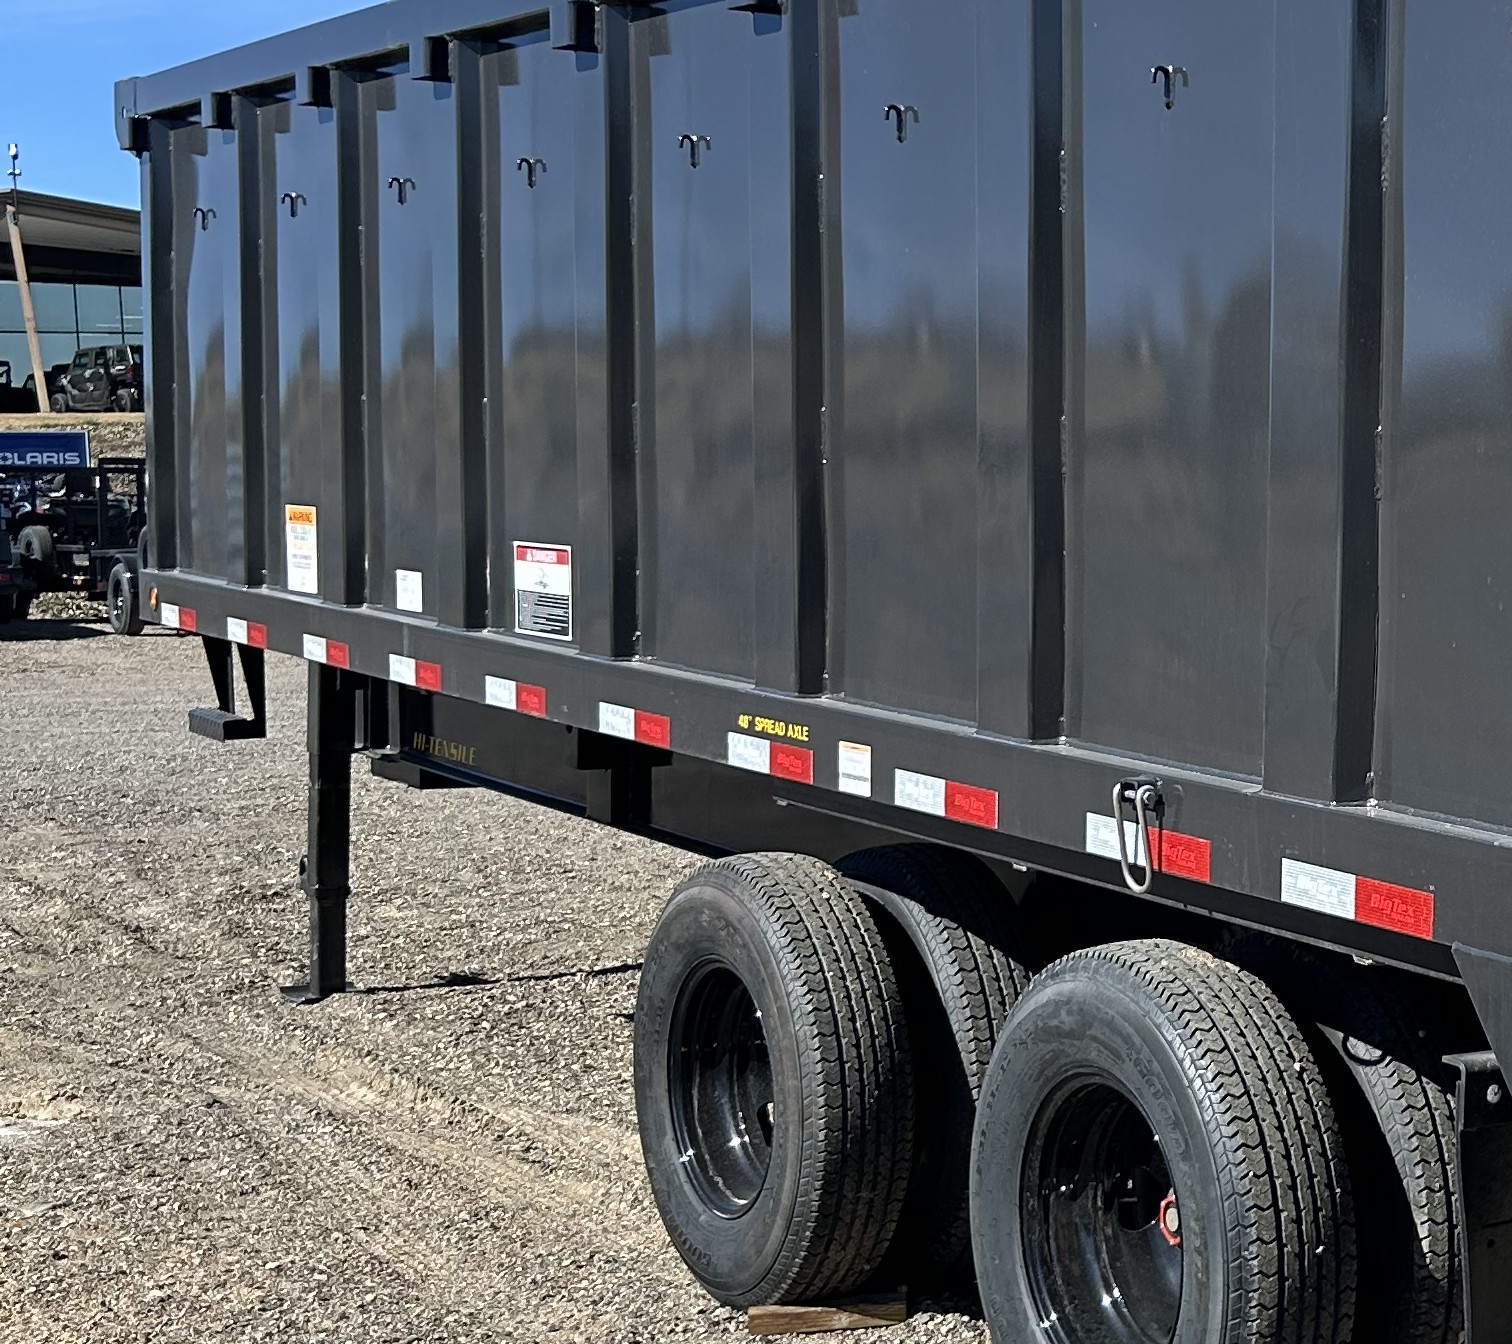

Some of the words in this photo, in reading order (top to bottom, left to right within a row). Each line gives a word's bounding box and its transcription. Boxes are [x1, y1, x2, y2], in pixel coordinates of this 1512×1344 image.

[754, 716, 786, 736] SPREAD
[787, 723, 809, 742] AXLE
[1370, 893, 1416, 917] BigTex
